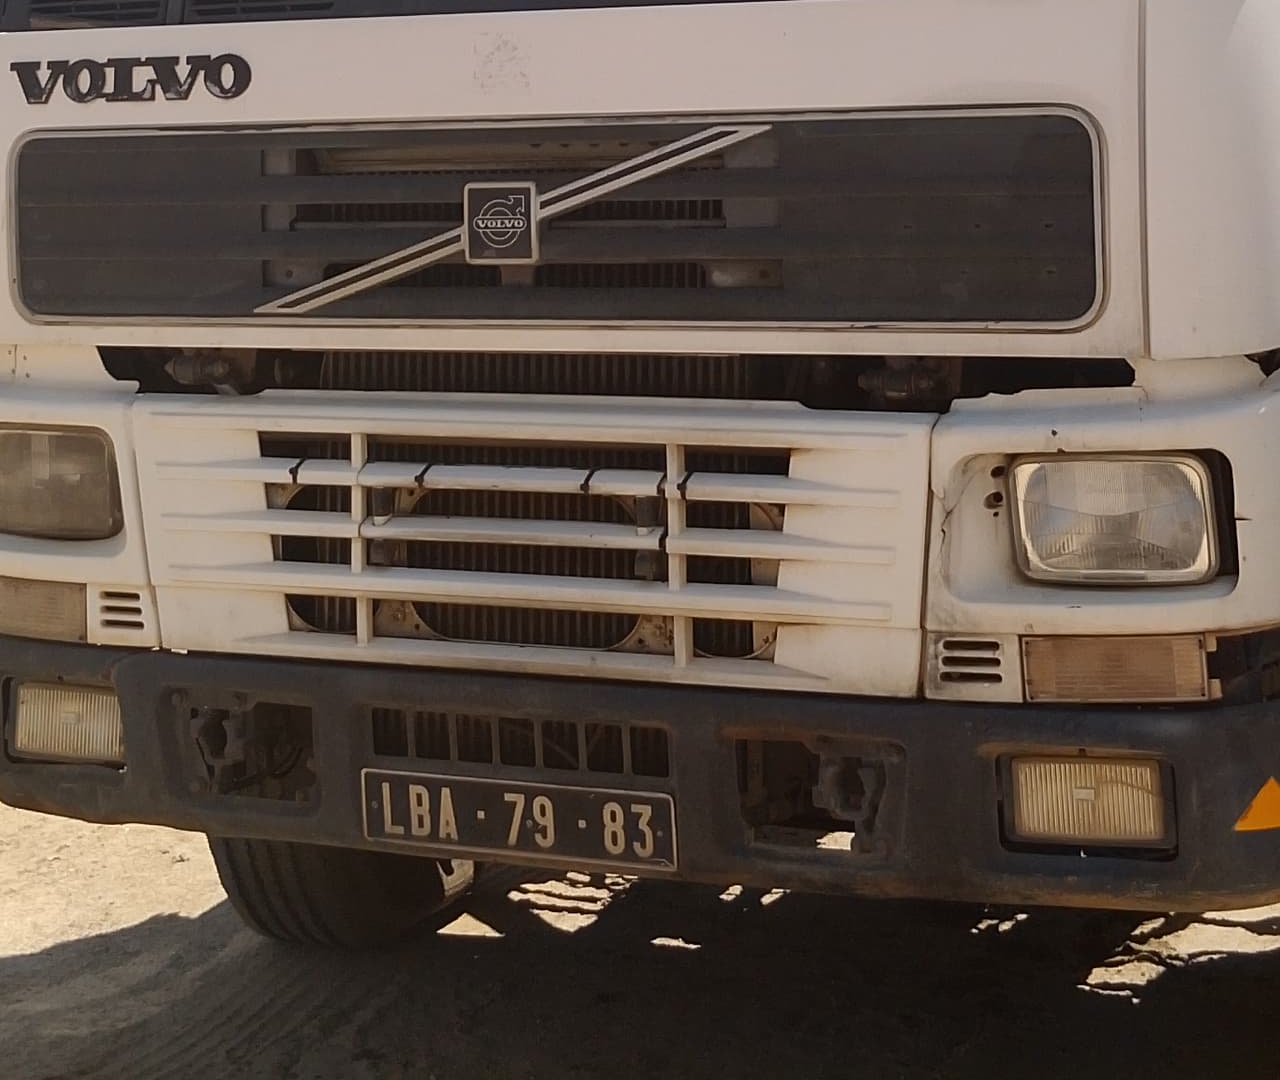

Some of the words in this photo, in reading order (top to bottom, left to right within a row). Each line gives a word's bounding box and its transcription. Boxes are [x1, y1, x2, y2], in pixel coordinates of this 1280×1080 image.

[10, 53, 252, 105] VOLVO
[477, 219, 524, 228] VOLVO
[381, 782, 459, 841] LBA
[504, 792, 555, 848] 79
[602, 801, 655, 858] 83
